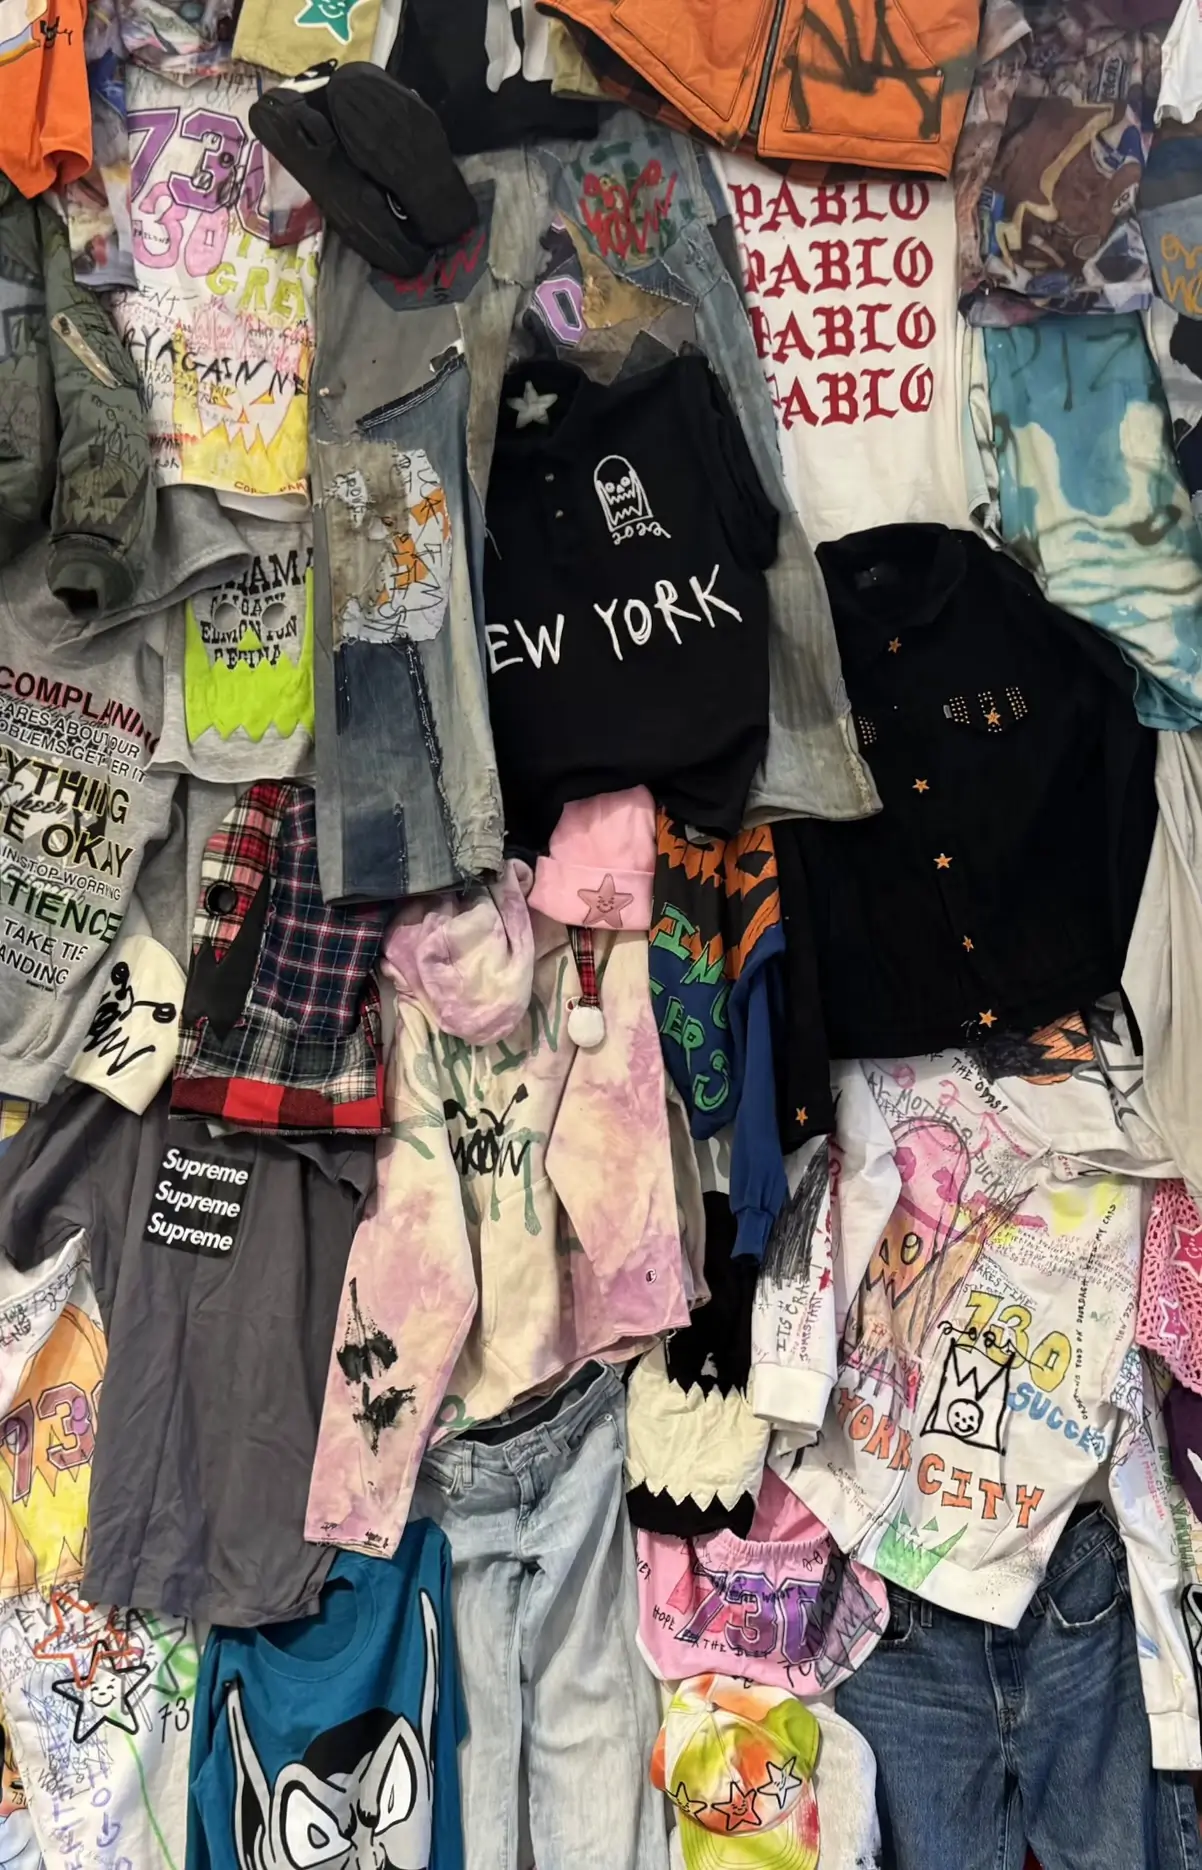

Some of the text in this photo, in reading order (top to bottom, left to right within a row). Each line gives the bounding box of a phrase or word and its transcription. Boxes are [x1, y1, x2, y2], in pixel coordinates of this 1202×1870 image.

[727, 180, 930, 236] PABLO
[763, 363, 935, 430] ABLO
[612, 521, 672, 545] 2022
[485, 563, 744, 674] EW YORK
[108, 734, 141, 760] OUR
[2, 747, 131, 825] YTHING
[41, 823, 135, 879] OKAY
[3, 918, 57, 956] TAKE
[951, 1056, 973, 1084] THE
[162, 1148, 249, 1185] Supreme
[155, 1180, 241, 1218] Supreme
[147, 1211, 234, 1251] Supreme
[837, 1387, 913, 1472] YORK
[917, 1453, 1044, 1529] CITY
[652, 1605, 677, 1633] HOPE
[157, 1696, 191, 1743] 73
